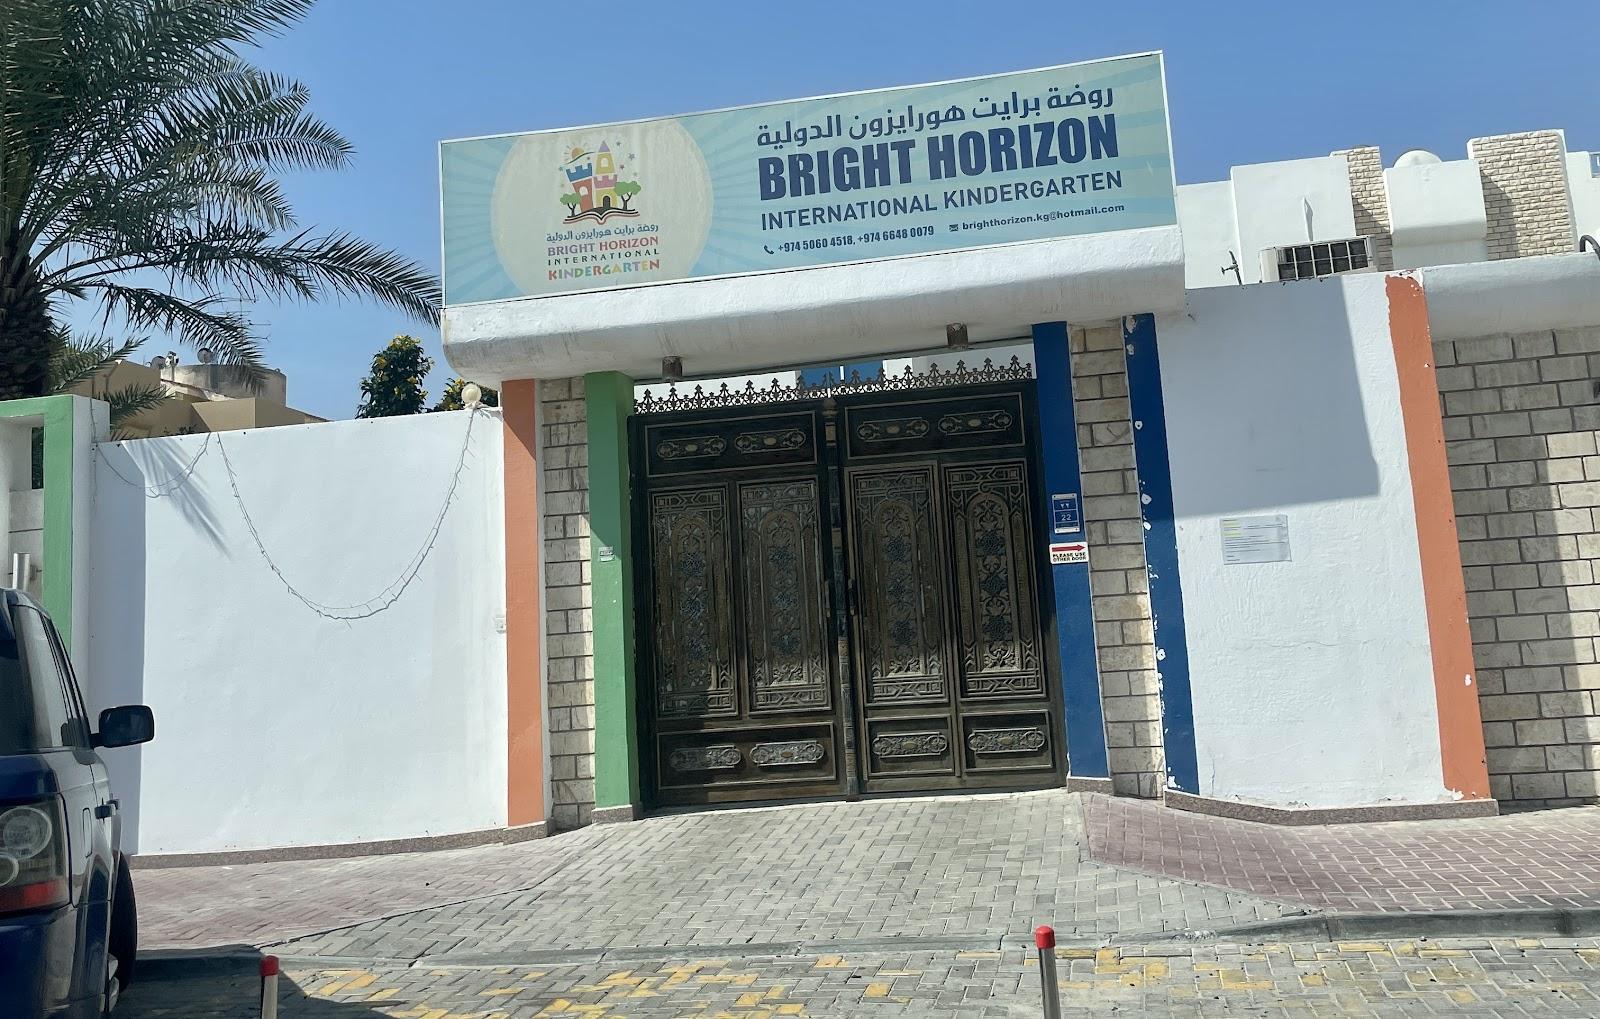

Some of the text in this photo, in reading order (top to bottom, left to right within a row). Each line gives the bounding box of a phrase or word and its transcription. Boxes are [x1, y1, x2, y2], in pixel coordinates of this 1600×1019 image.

[757, 84, 1113, 150] روضة برايت هورايزون الدولية
[758, 113, 1119, 201] BRIGHT HORIZON
[761, 169, 1123, 231] INTERNATIONAL KINDERGARTEN
[637, 224, 659, 233] روضة
[962, 204, 1125, 231] brighthorizon.kg@hotmail.com
[546, 230, 573, 243] الدولية
[614, 225, 635, 236] برايت
[778, 241, 801, 253] +974
[802, 238, 828, 251] 5060
[857, 231, 881, 244] +974
[882, 228, 908, 241] 6648
[910, 225, 935, 238] 0079
[547, 235, 659, 257] BRIGHT HORIZON
[548, 248, 660, 266] INTERNATIONAL
[548, 259, 660, 281] KINDERGARTEN
[1061, 513, 1072, 521] 22
